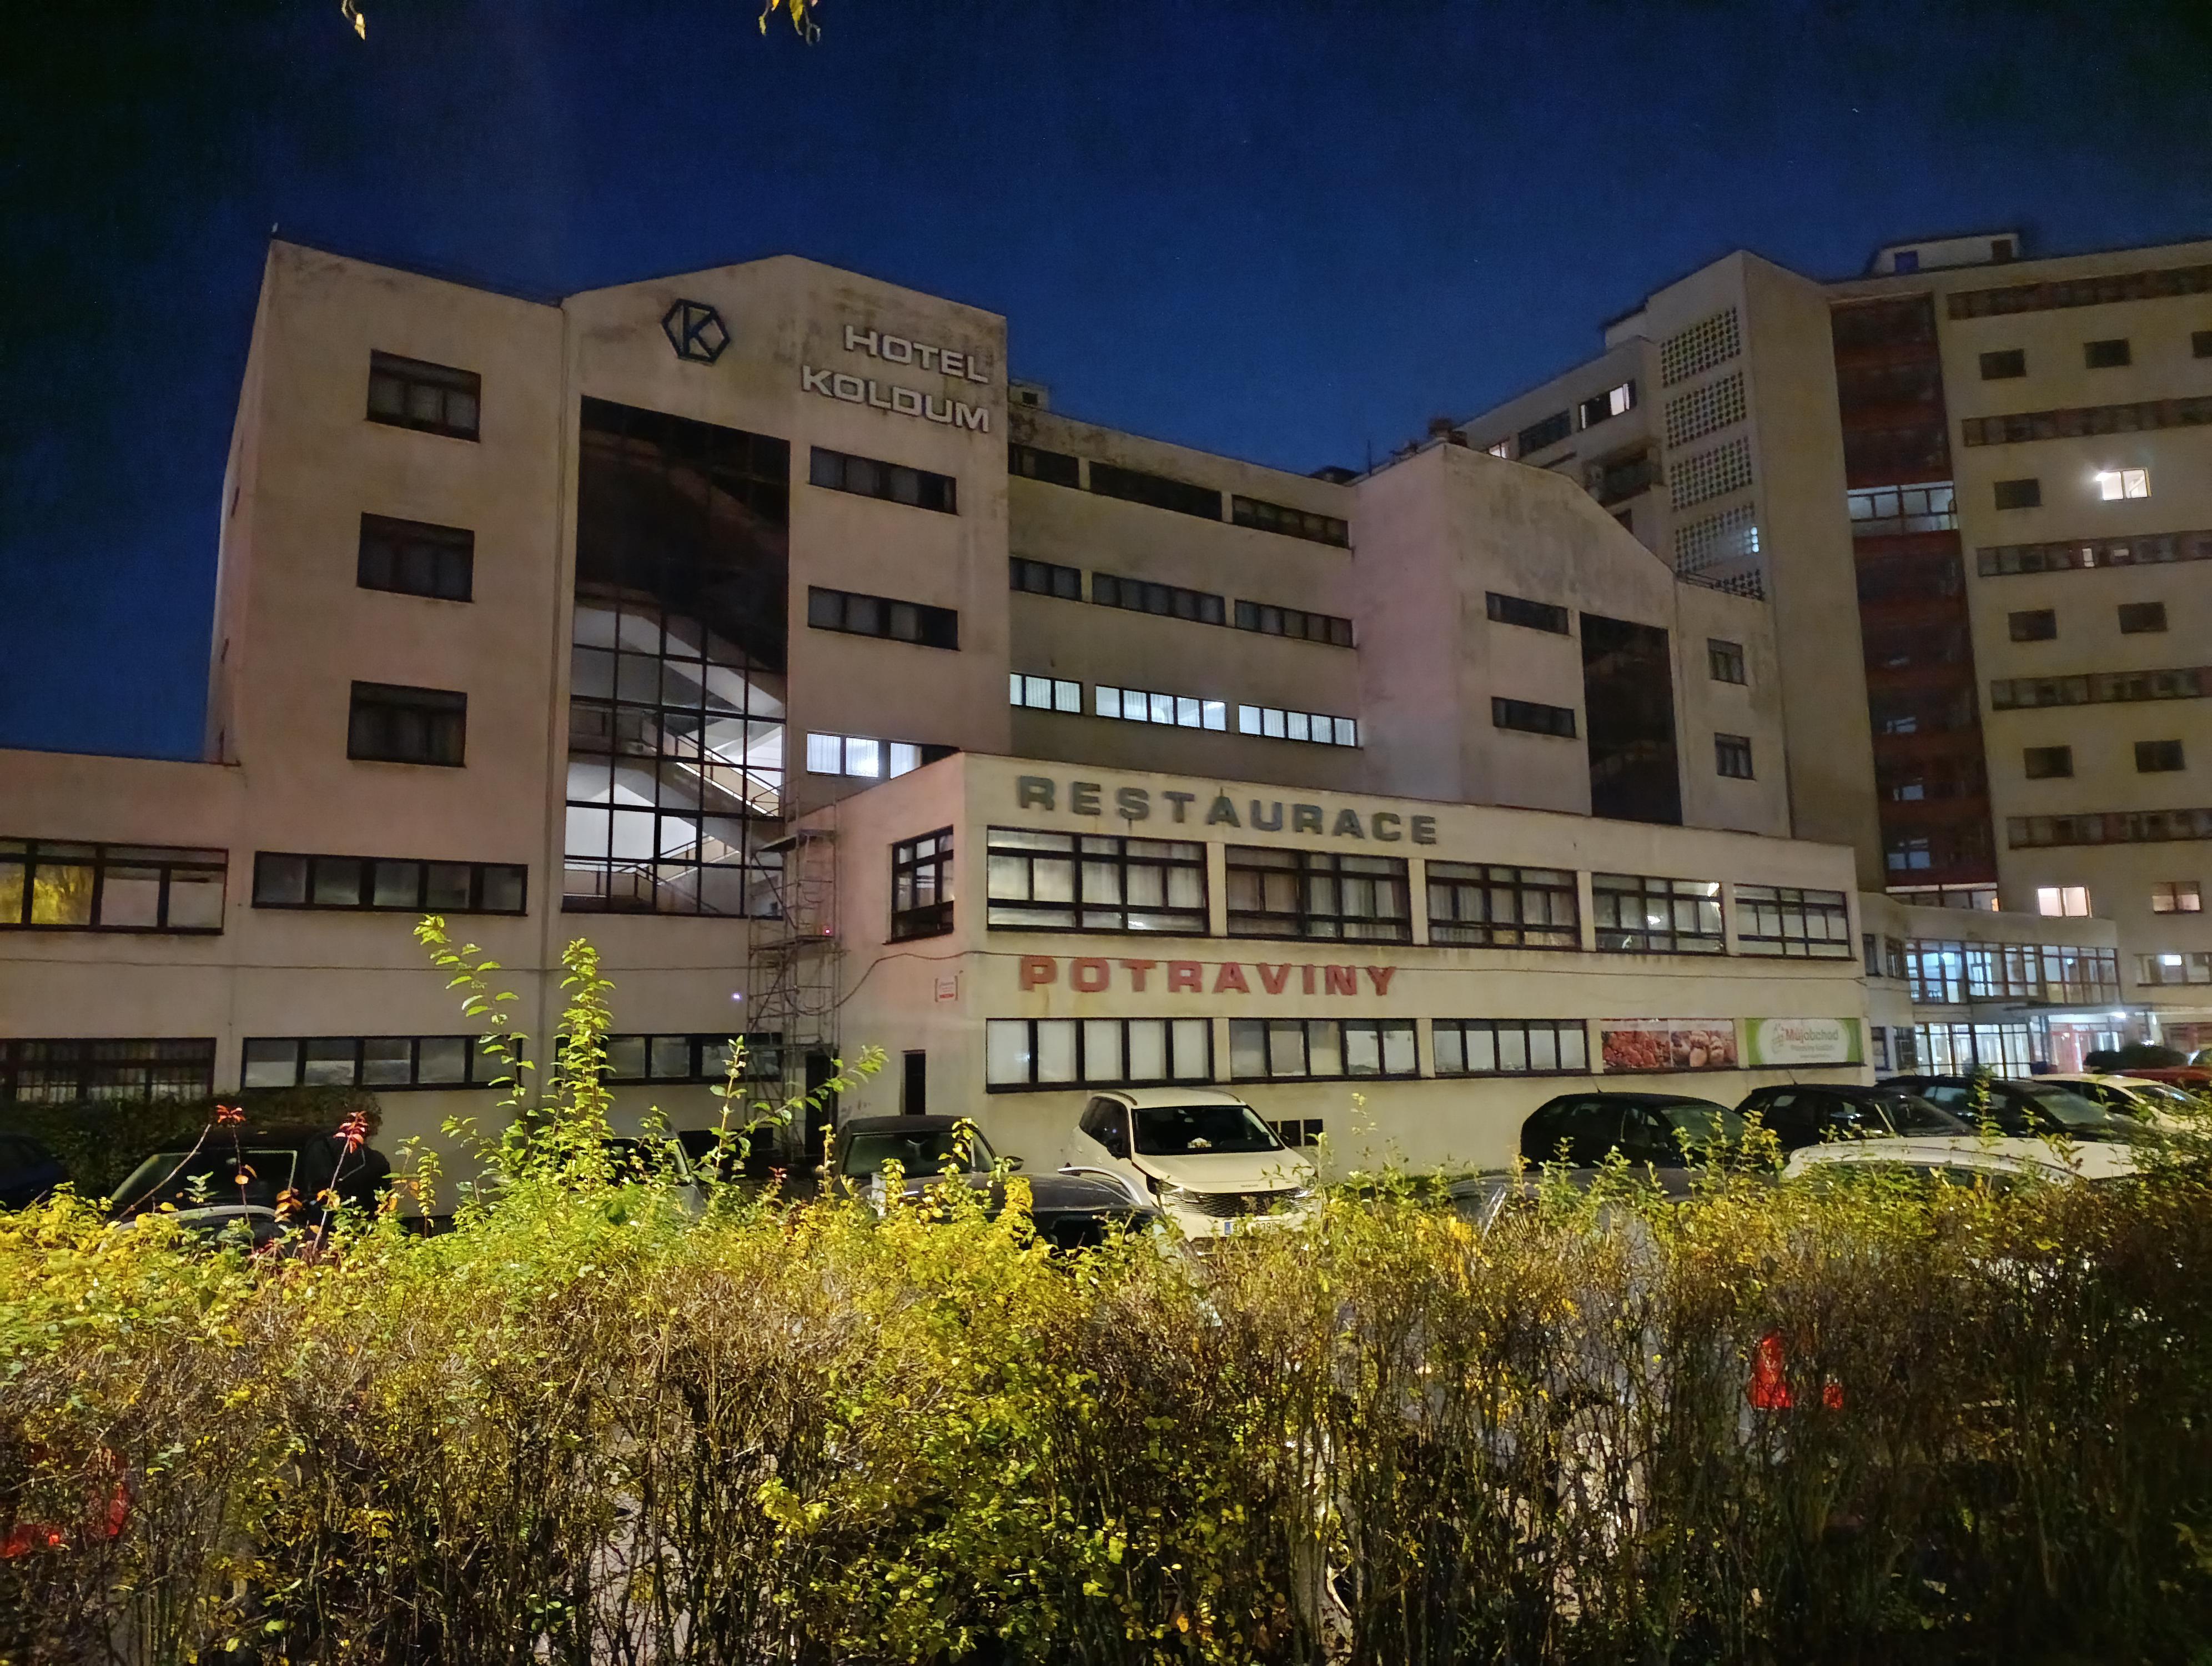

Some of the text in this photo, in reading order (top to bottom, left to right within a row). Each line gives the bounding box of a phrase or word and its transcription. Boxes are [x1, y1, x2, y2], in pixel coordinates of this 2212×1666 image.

[844, 324, 989, 384] HOTEL
[801, 364, 990, 433] KOLDUM
[1017, 775, 1437, 845] RESTAURACE
[1019, 955, 1396, 996] POTRAVINY
